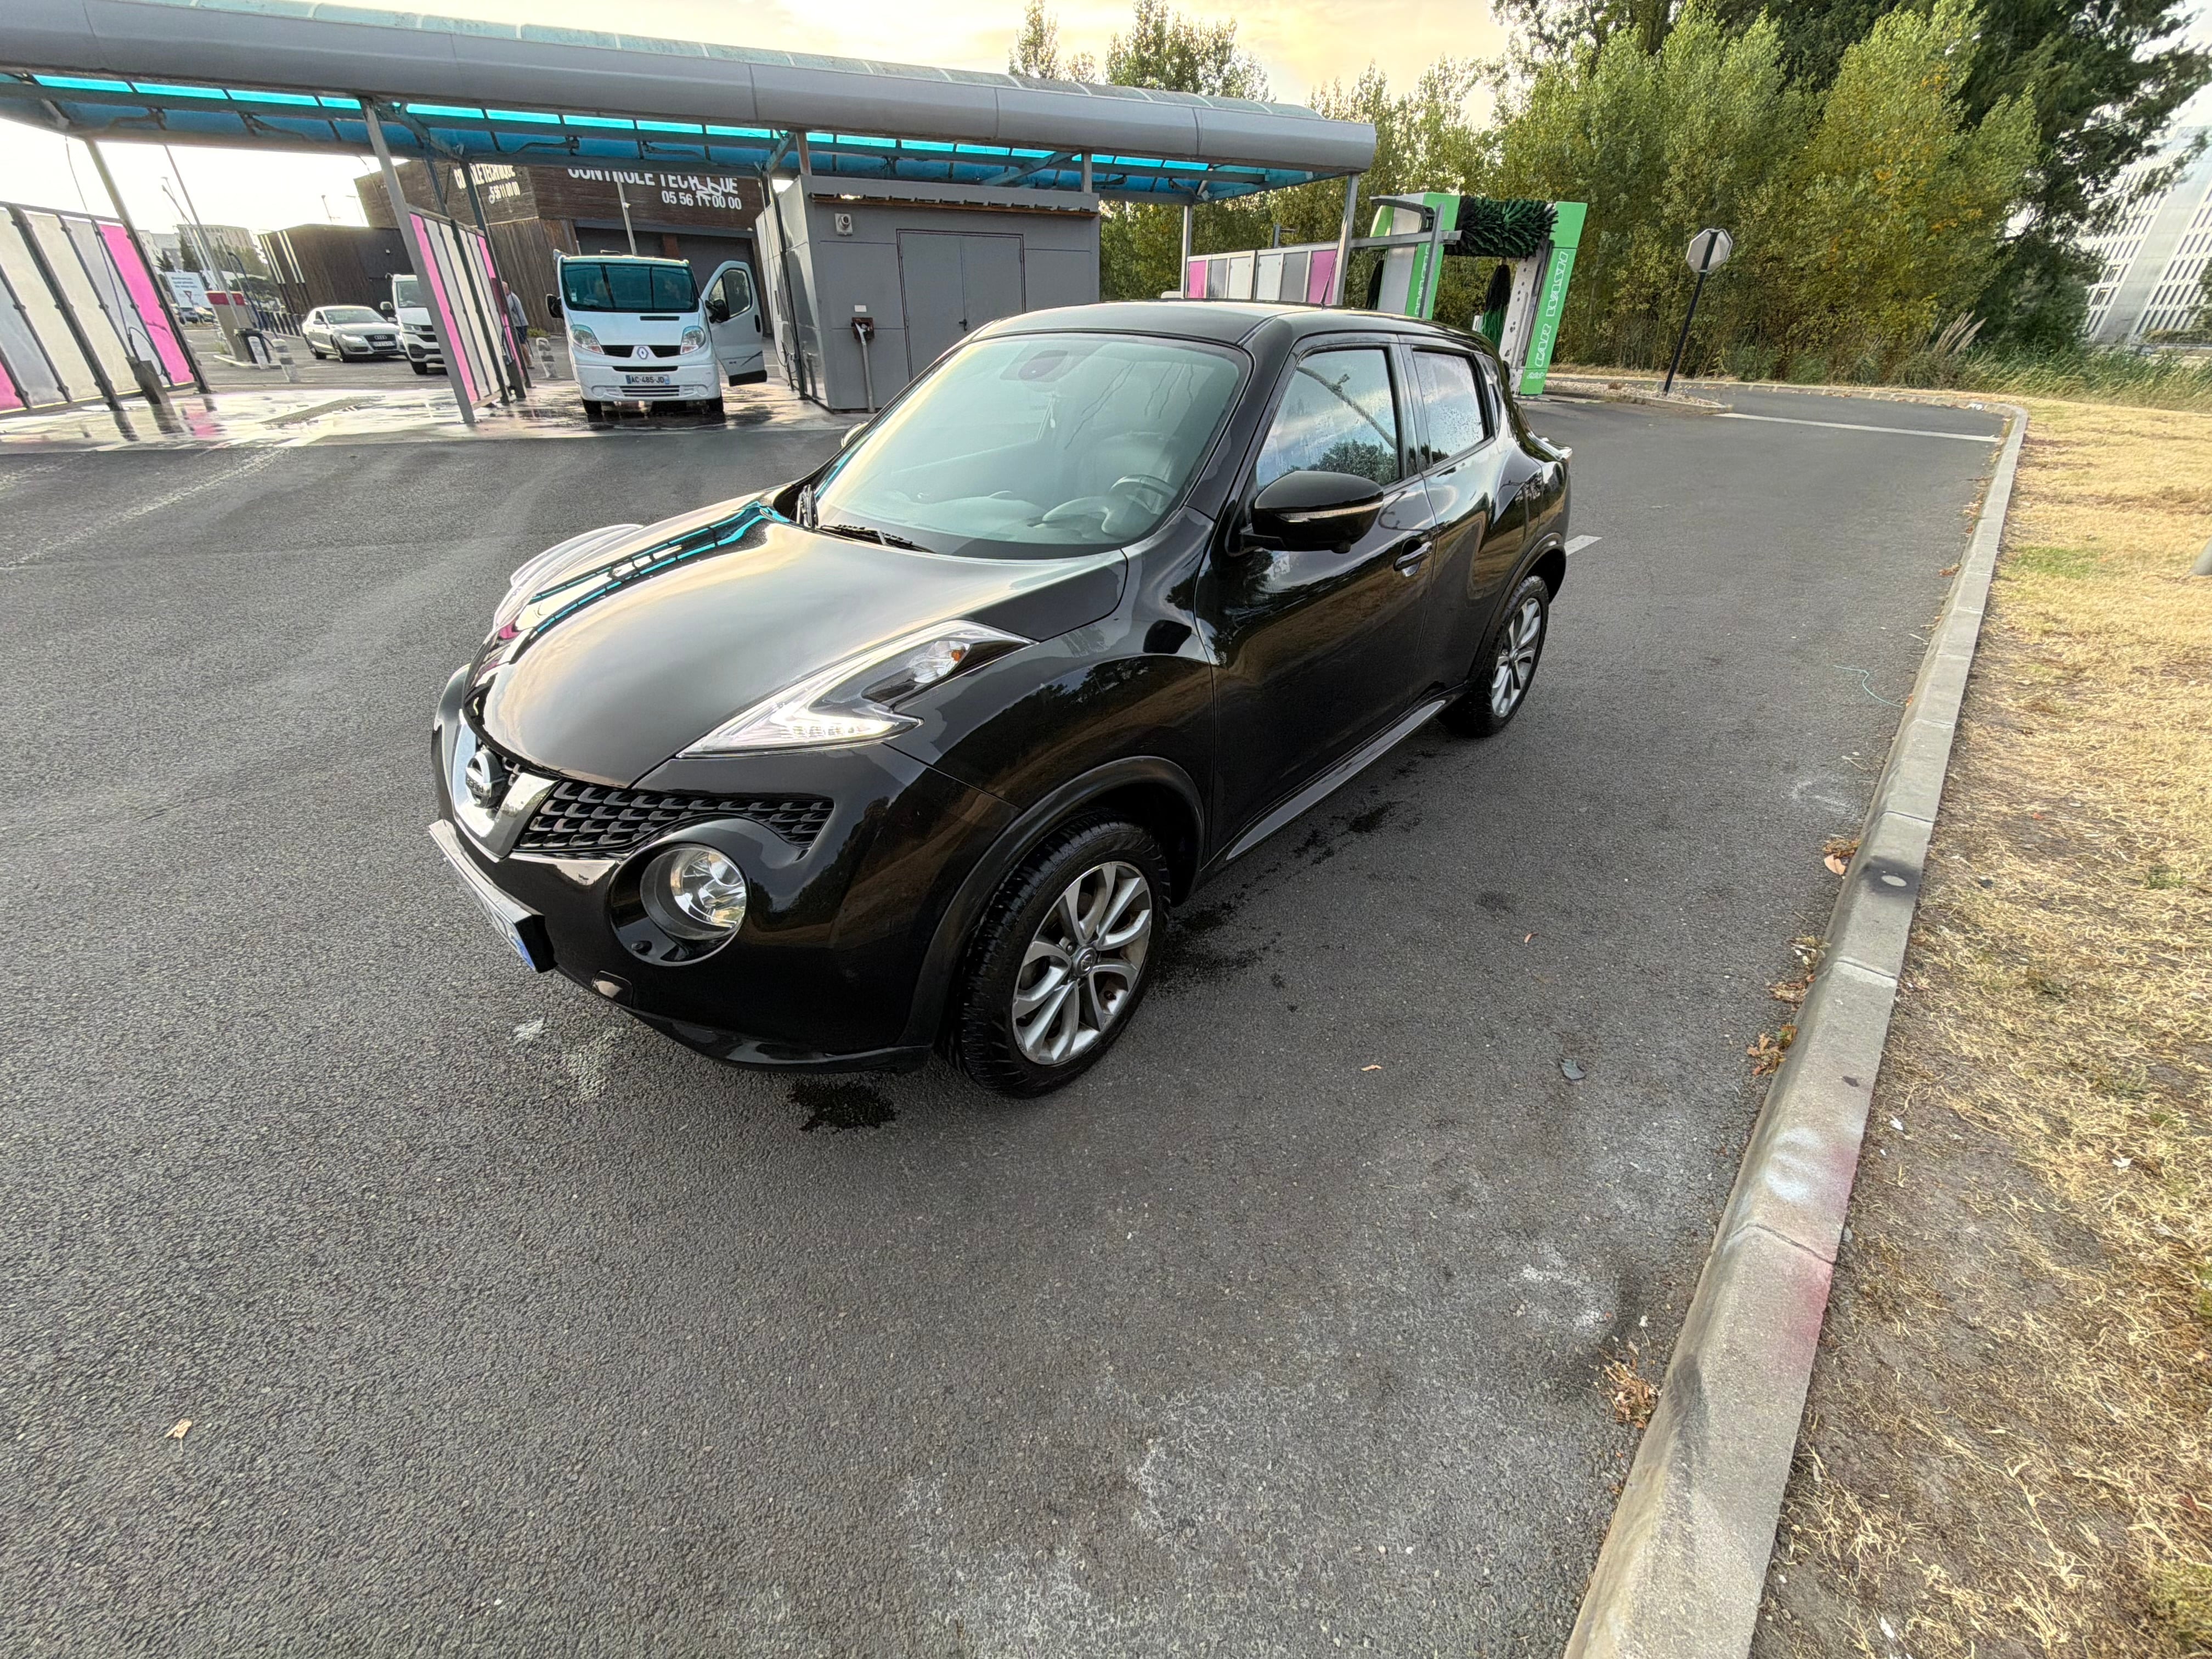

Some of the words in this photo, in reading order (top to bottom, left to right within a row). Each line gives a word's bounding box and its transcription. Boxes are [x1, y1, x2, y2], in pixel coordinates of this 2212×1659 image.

[662, 190, 677, 205] 05
[679, 192, 694, 207] 56
[712, 195, 726, 208] 00
[728, 196, 742, 210] 00
[1535, 323, 1551, 367] CAR
[1546, 251, 1568, 317] WASH
